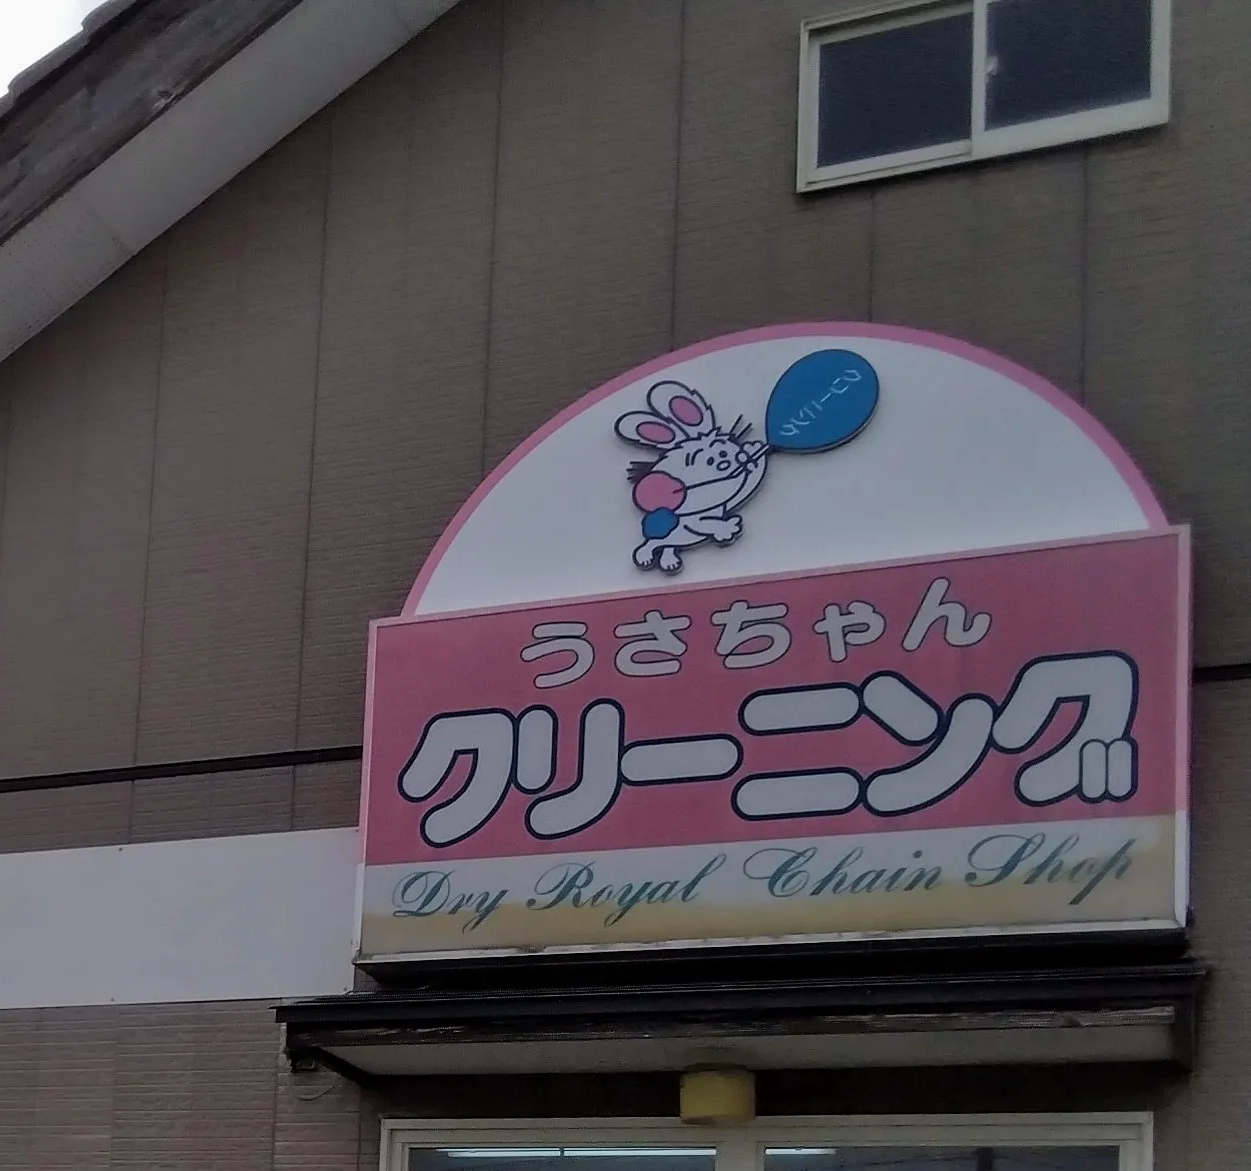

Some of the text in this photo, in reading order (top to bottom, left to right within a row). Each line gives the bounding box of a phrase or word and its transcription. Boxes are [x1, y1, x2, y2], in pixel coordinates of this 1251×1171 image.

[521, 578, 993, 690] うさちゃん
[397, 649, 1140, 849] クリーニング
[392, 831, 1134, 935] Dry Royal Chain Shop
